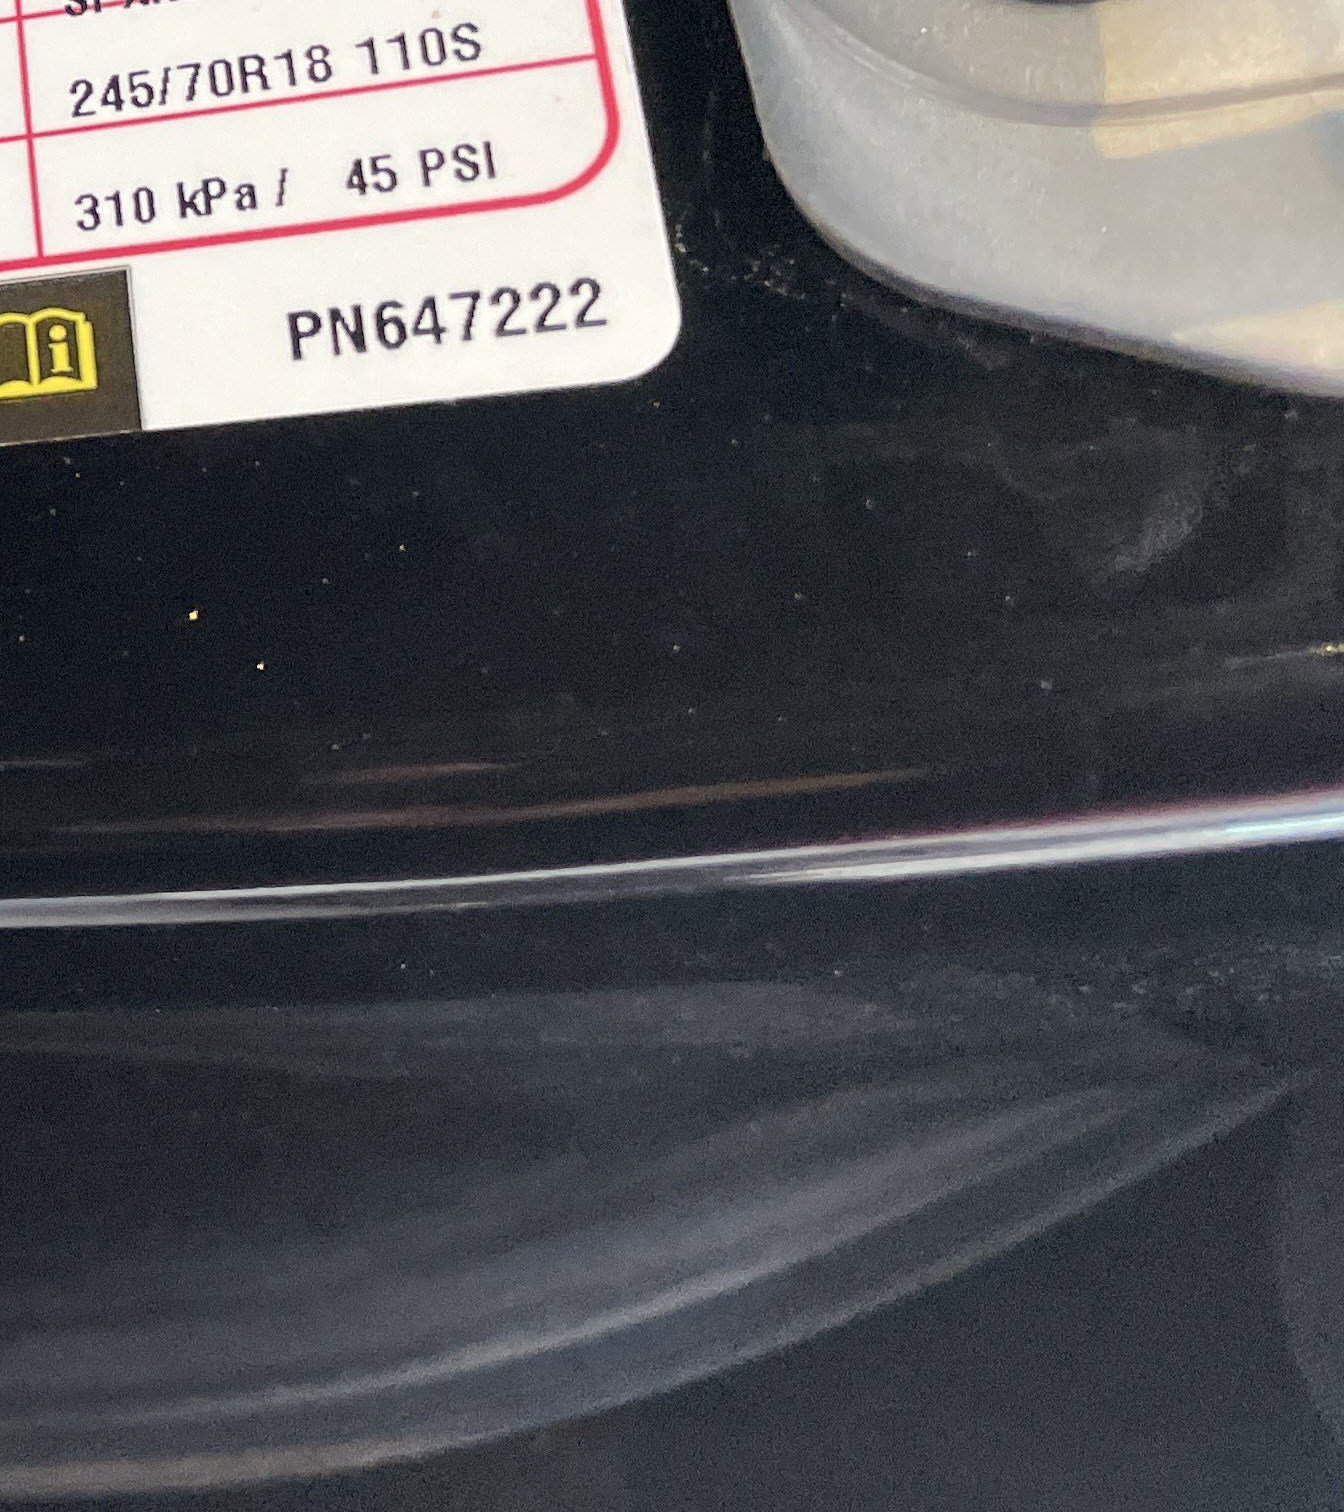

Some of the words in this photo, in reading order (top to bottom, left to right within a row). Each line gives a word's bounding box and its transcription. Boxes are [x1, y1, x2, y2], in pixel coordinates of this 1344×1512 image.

[69, 43, 332, 118] 245/70R18
[356, 21, 482, 76] 110S
[75, 187, 156, 232] 310
[177, 177, 257, 219] kPa
[275, 167, 289, 207] /
[345, 155, 398, 196] 45
[419, 140, 498, 189] PSI
[287, 277, 607, 361] PN647222
